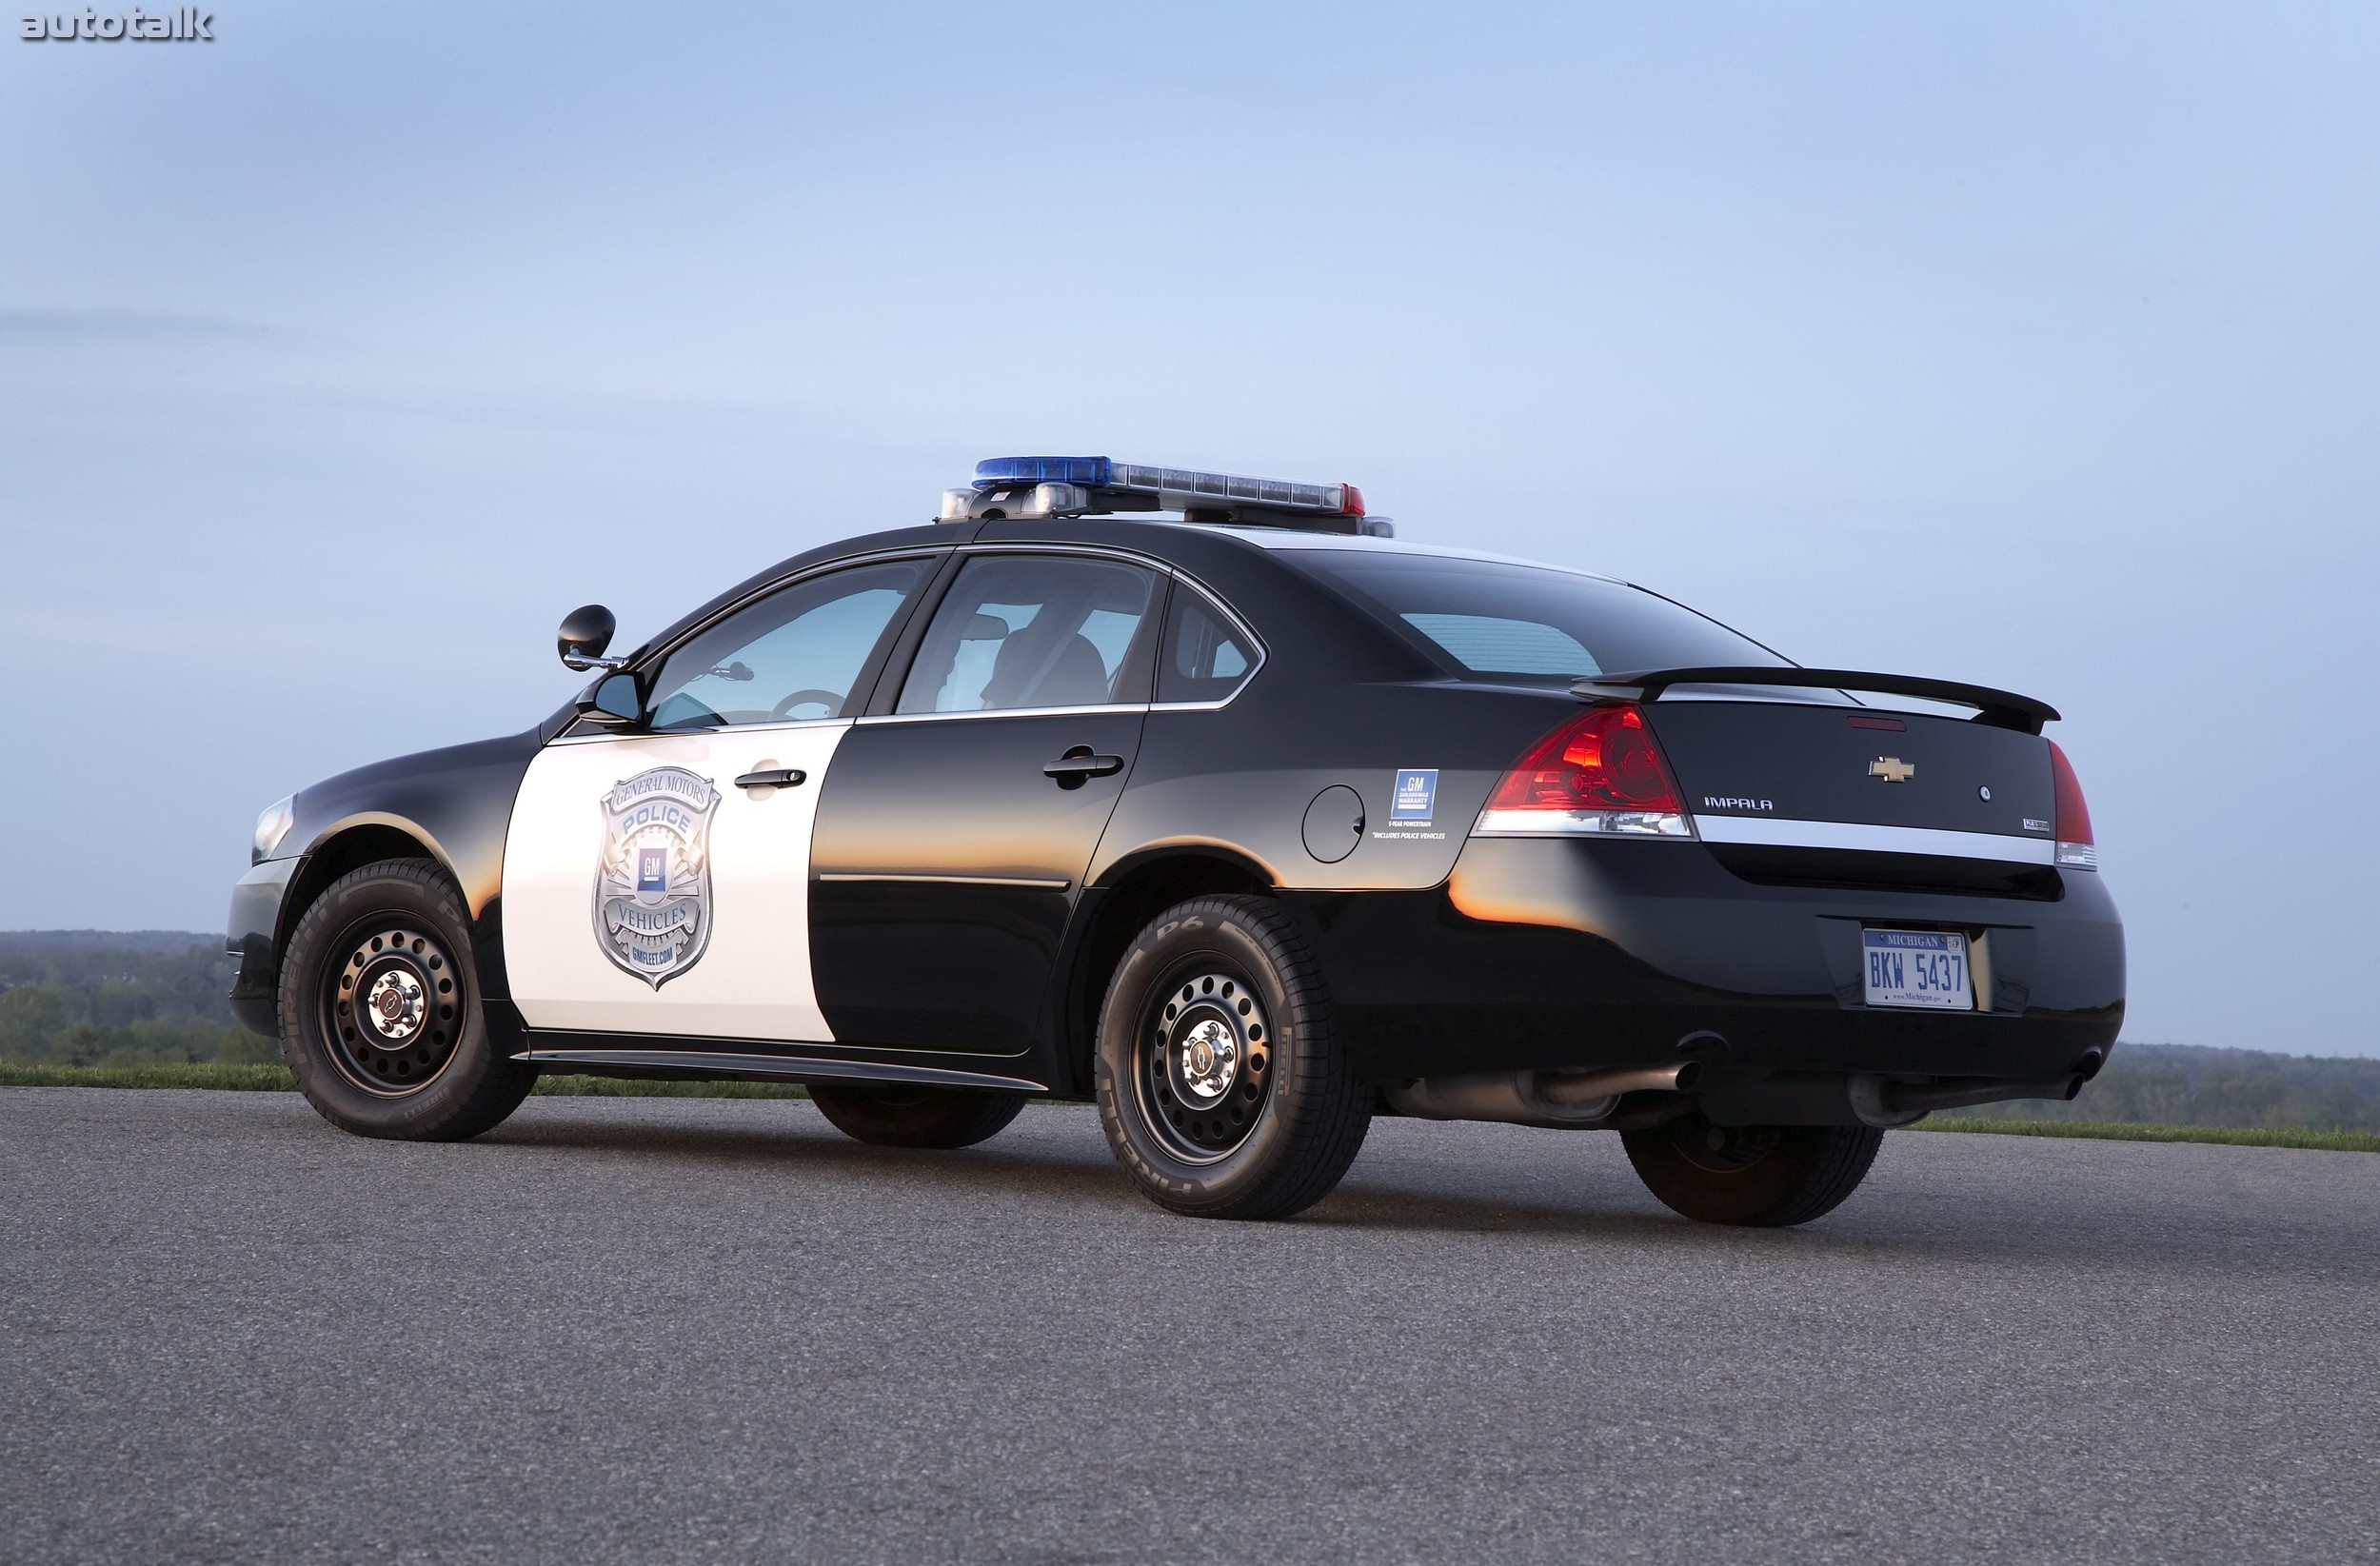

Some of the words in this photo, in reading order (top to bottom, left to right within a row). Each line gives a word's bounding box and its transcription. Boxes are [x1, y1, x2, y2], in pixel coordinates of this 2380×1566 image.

[616, 776, 663, 805] GENERAL
[665, 776, 705, 804] MOTORS
[1407, 777, 1424, 792] GM
[1704, 797, 1774, 810] IMPALA
[623, 805, 691, 835] POLICE
[644, 858, 661, 876] GM
[618, 902, 686, 930] VEHICLES
[1157, 915, 1203, 942] P6
[1888, 935, 1938, 947] MICHIGAN
[632, 946, 673, 966] GMFLEET.COM
[1870, 952, 1904, 989] BKW
[1915, 953, 1962, 992] 5437
[1893, 992, 1942, 1002] www.Michigan.gov
